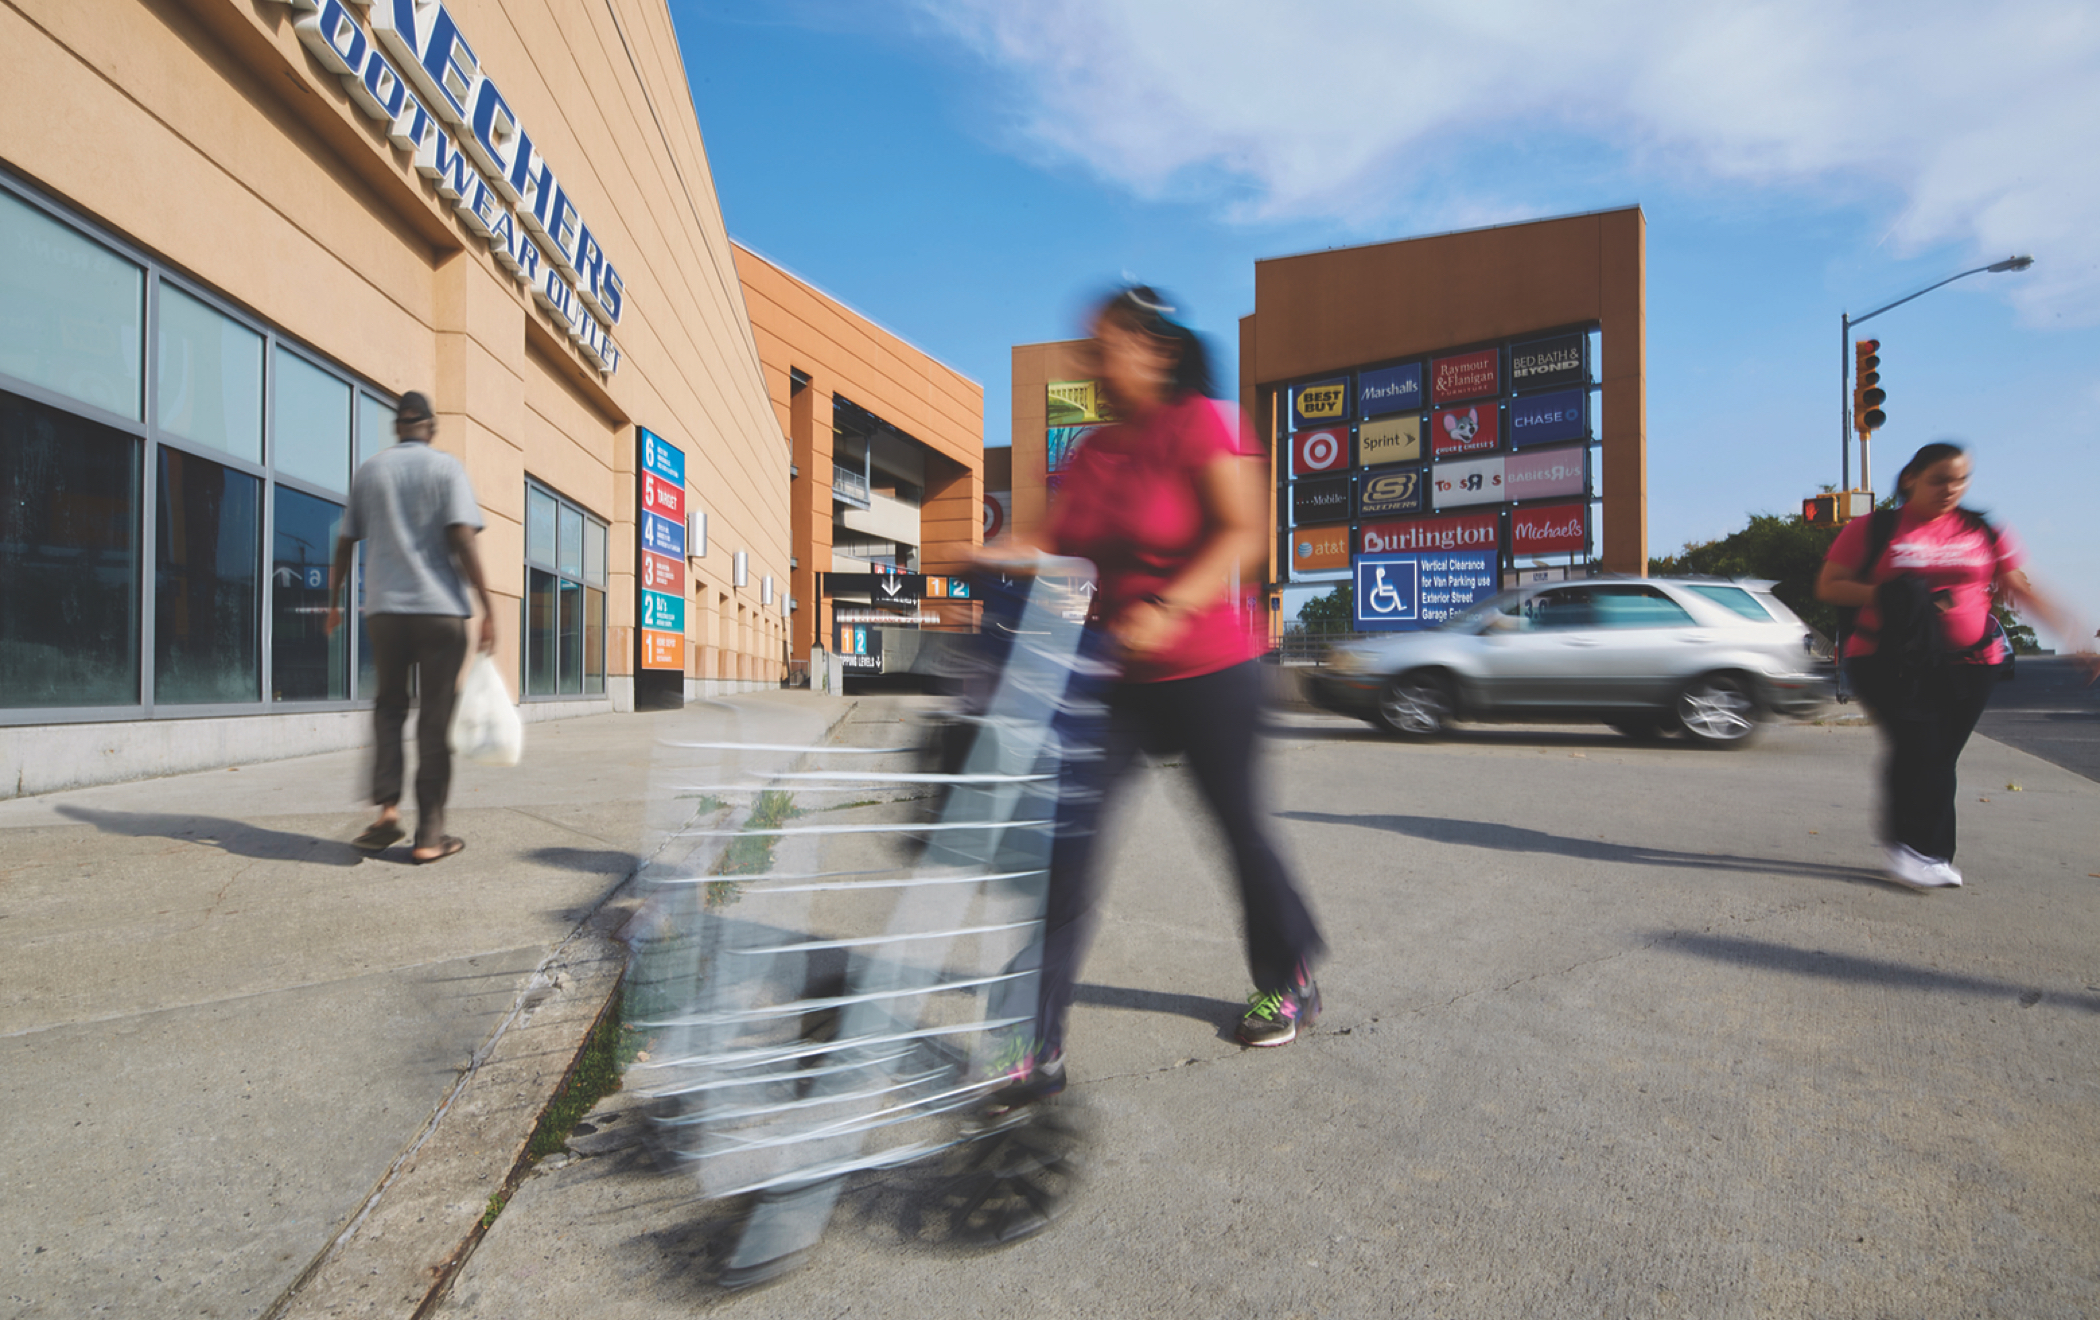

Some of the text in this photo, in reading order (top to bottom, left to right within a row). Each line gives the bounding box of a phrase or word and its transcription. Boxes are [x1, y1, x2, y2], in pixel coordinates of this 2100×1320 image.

[391, 0, 626, 325] ECHERS
[313, 0, 622, 375] OOTWEAR OUTLET
[1441, 359, 1489, 376] Raymour
[1513, 348, 1579, 369] BED BATH &
[1513, 360, 1579, 378] BEYOND
[1304, 391, 1341, 403] BEST
[1361, 380, 1418, 401] Marshalls
[1304, 402, 1337, 413] BUY
[1514, 411, 1563, 428] CHASE
[1363, 434, 1400, 452] Sprint
[645, 438, 654, 467] 6
[645, 475, 677, 511] 5 TARGET
[1362, 500, 1417, 511] SKECHERS
[645, 516, 654, 546] 4
[1364, 526, 1494, 553] Burlington
[1315, 540, 1345, 555] at&t
[645, 557, 653, 586] 3
[1421, 558, 1485, 572] Vertical Clearance
[931, 579, 965, 596] 1 2
[1422, 575, 1490, 589] for Van Parking use
[1422, 591, 1473, 604] Exterior Street
[645, 595, 653, 625] 2
[1422, 608, 1447, 622] Garage
[646, 634, 652, 664] 1
[844, 631, 865, 652] 1 2
